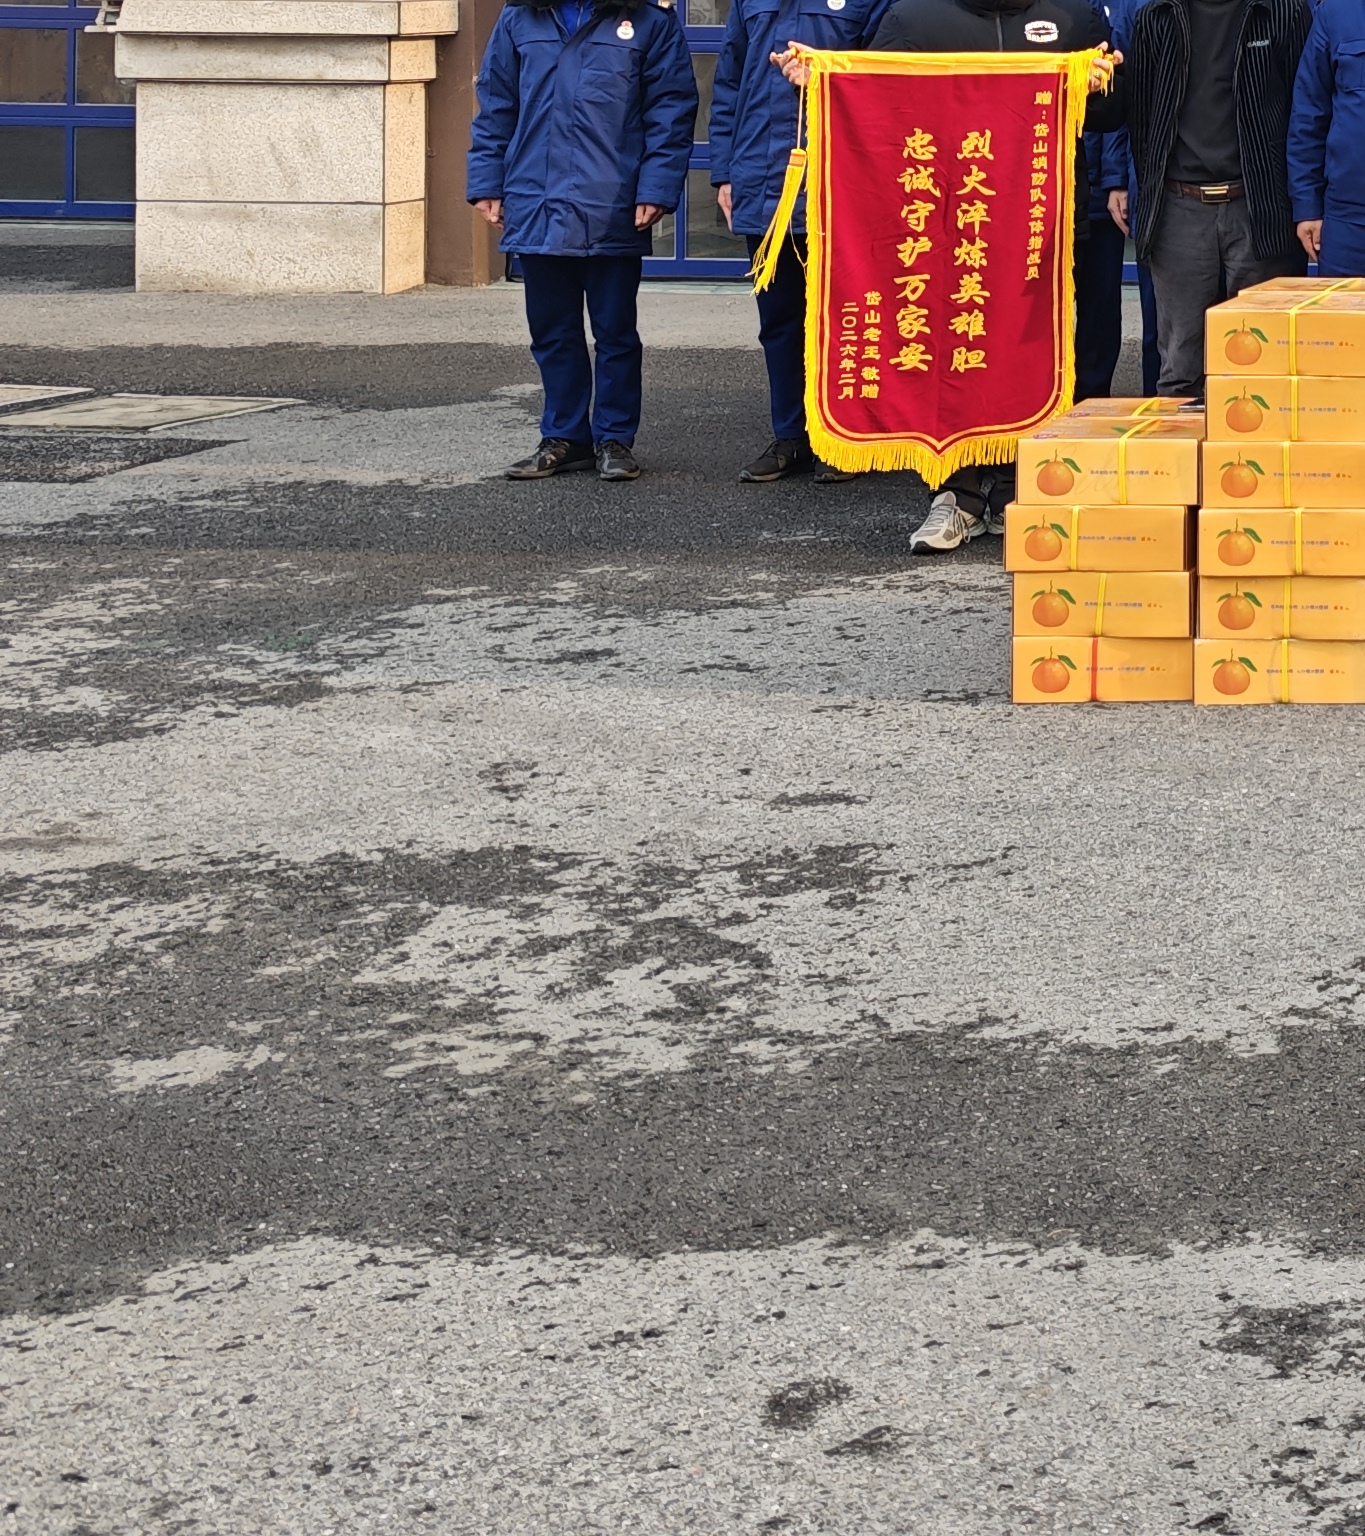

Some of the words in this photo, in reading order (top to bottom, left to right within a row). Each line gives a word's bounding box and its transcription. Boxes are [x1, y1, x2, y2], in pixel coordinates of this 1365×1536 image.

[859, 290, 883, 400] 岱山老王敬赠
[888, 127, 941, 372] 忠诚守护万家安
[949, 129, 996, 373] 烈火淬炼英雄胆
